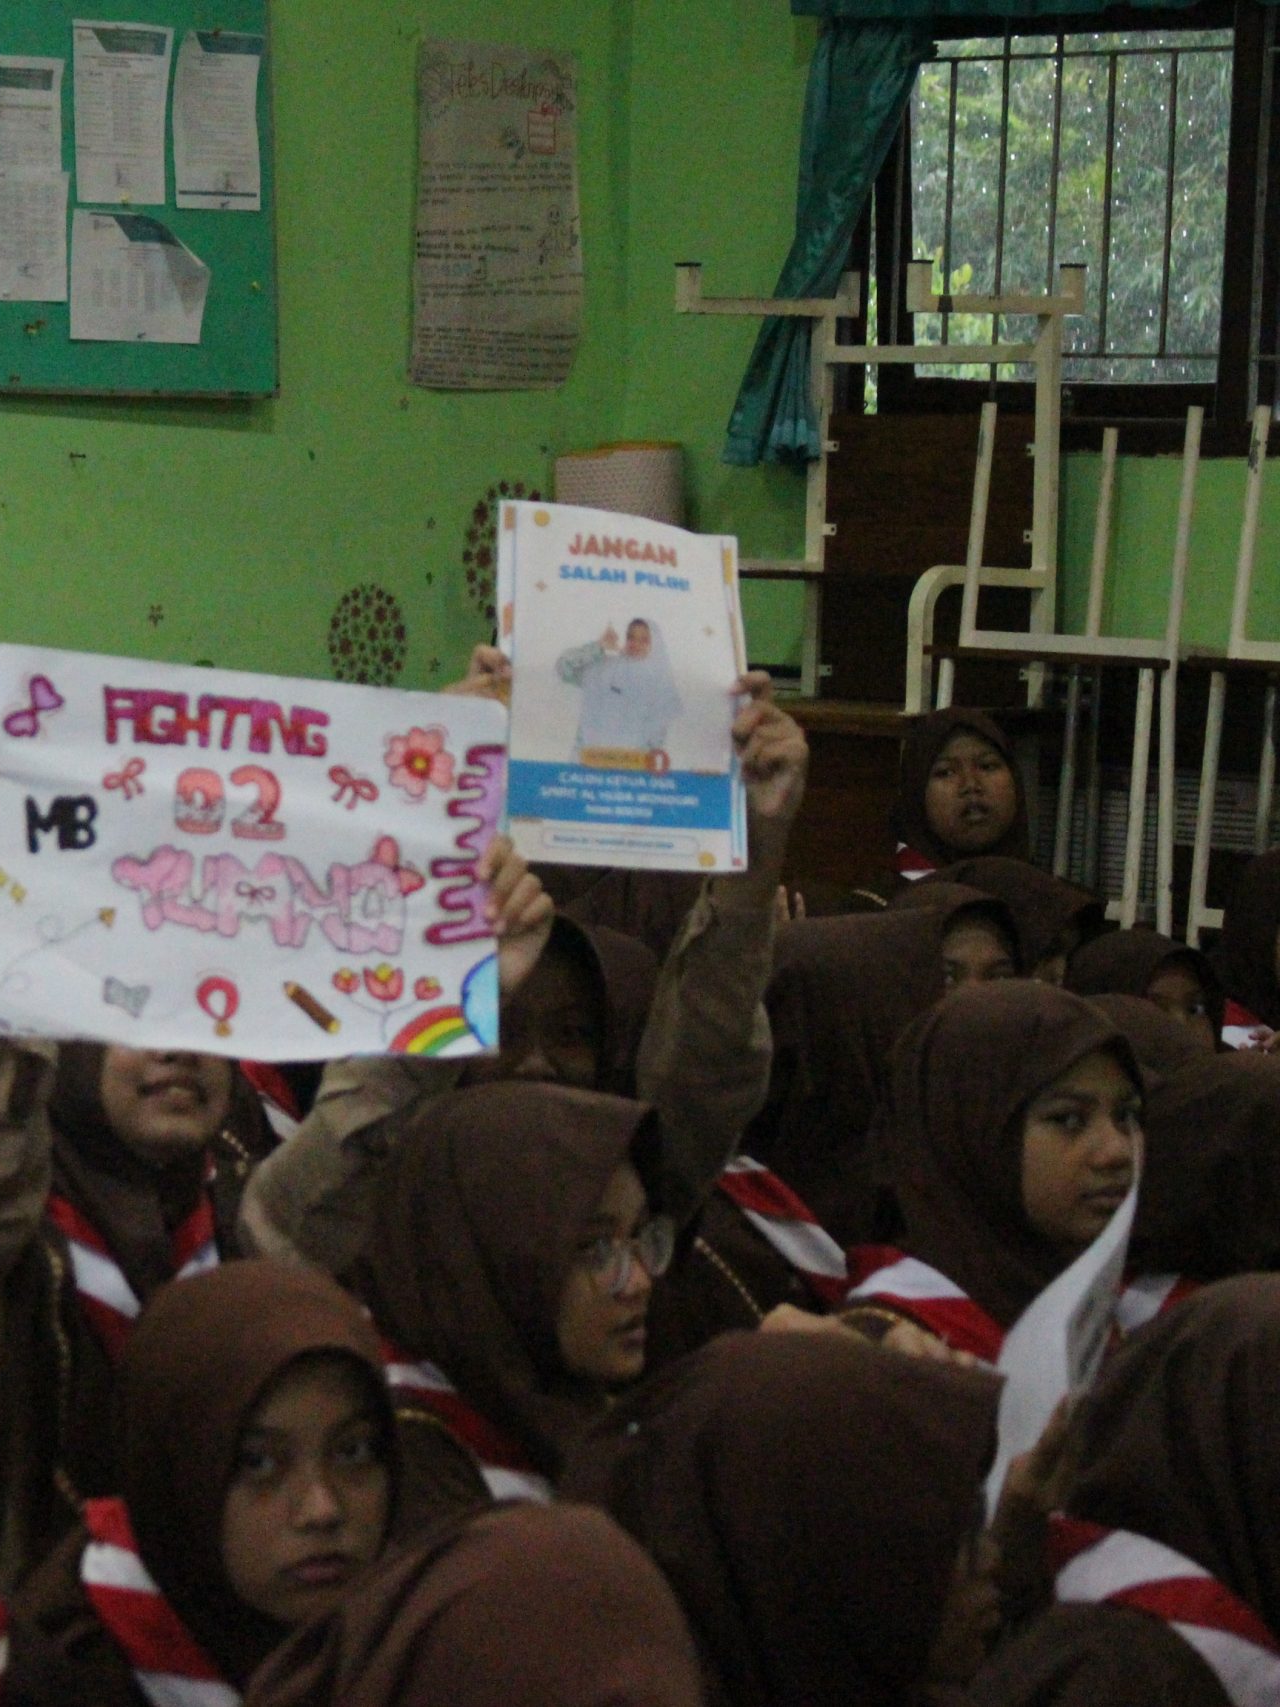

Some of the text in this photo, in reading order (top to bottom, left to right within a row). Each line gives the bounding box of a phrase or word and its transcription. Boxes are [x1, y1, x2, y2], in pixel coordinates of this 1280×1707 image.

[559, 564, 626, 584] SALAH
[568, 533, 678, 568] JANGAN
[25, 794, 99, 855] MB
[173, 763, 287, 841] 02
